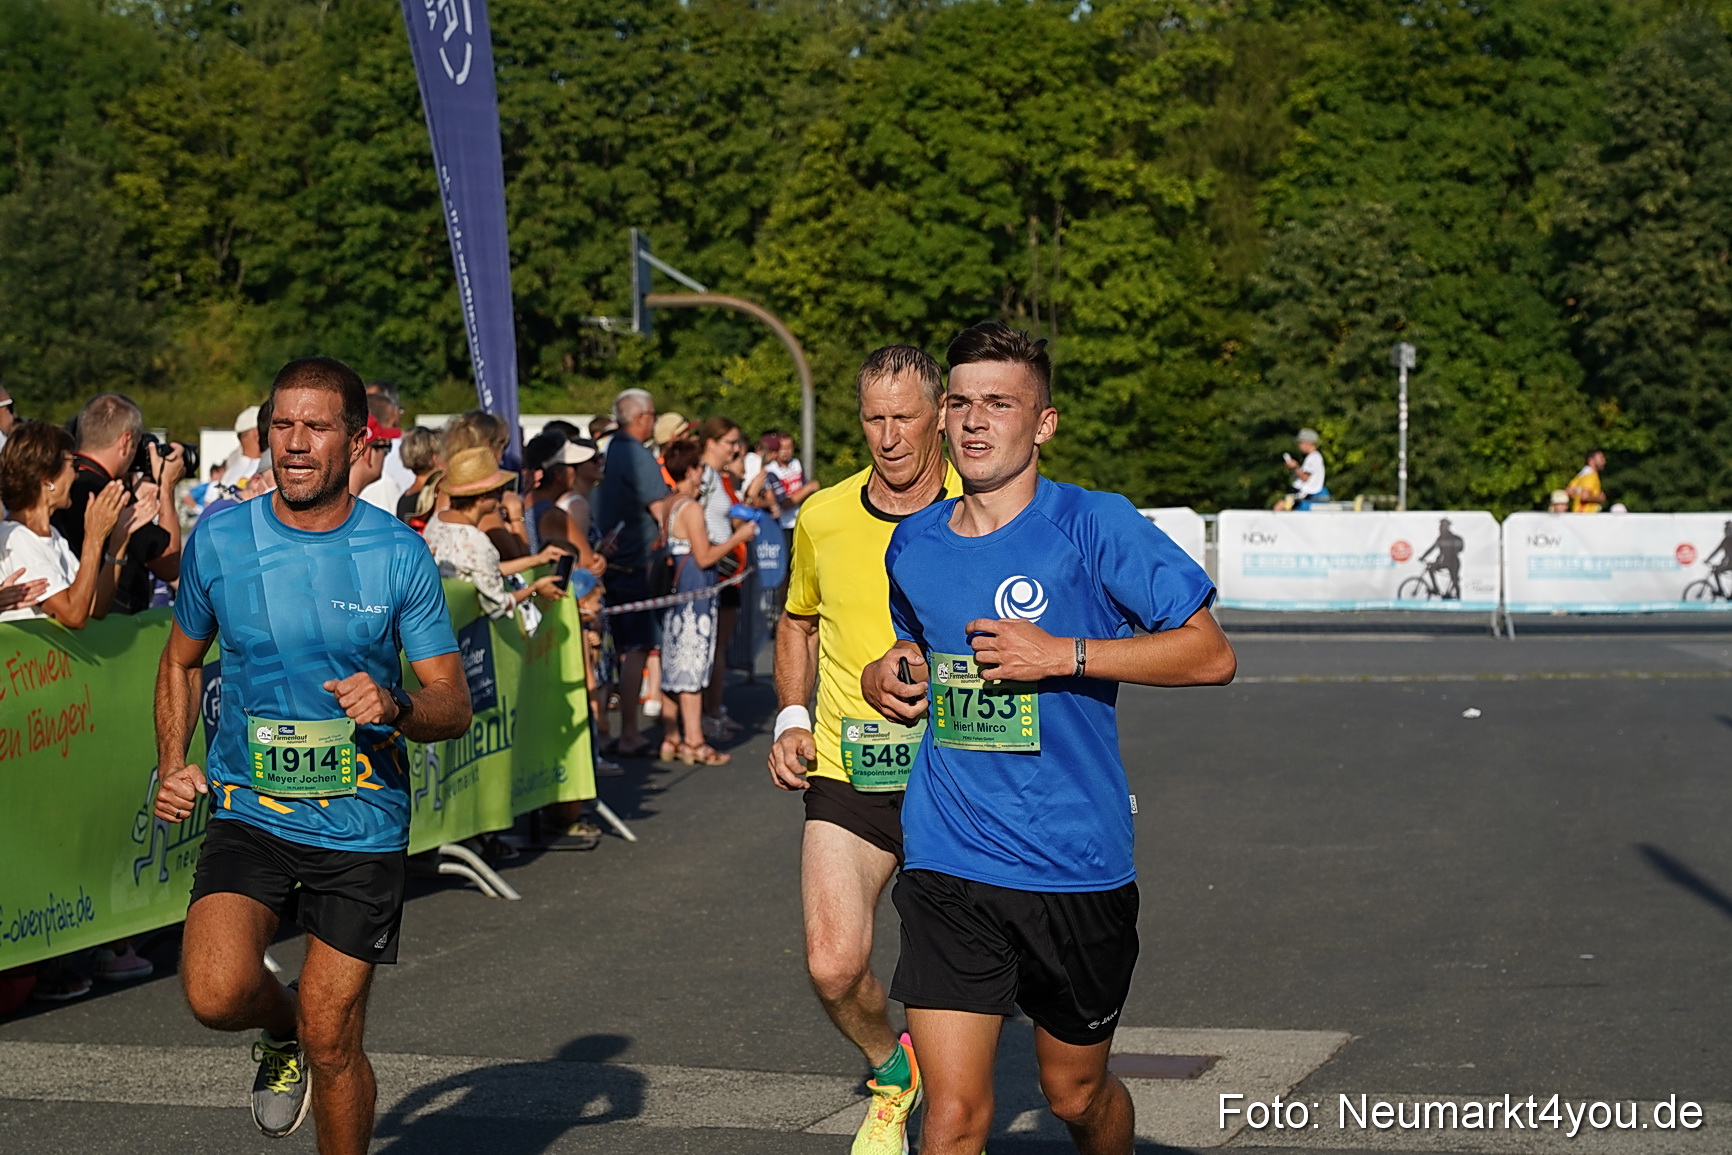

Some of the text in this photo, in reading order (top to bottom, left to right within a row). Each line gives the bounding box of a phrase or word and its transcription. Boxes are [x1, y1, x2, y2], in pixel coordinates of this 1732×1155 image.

[348, 602, 390, 614] PLAST
[6, 649, 73, 697] Firmen
[936, 695, 946, 728] RUN
[944, 687, 1017, 720] 1753
[1020, 693, 1033, 737] 2022
[27, 683, 95, 758] länger!
[953, 720, 1007, 734] Hierl Mirco
[254, 752, 264, 779] RUN
[265, 745, 339, 772] 1914
[340, 748, 352, 784] 2022
[844, 750, 854, 776] RUN
[860, 743, 911, 768] 548
[267, 772, 337, 785] Meyer Jochen
[852, 767, 897, 778] Graspointner
